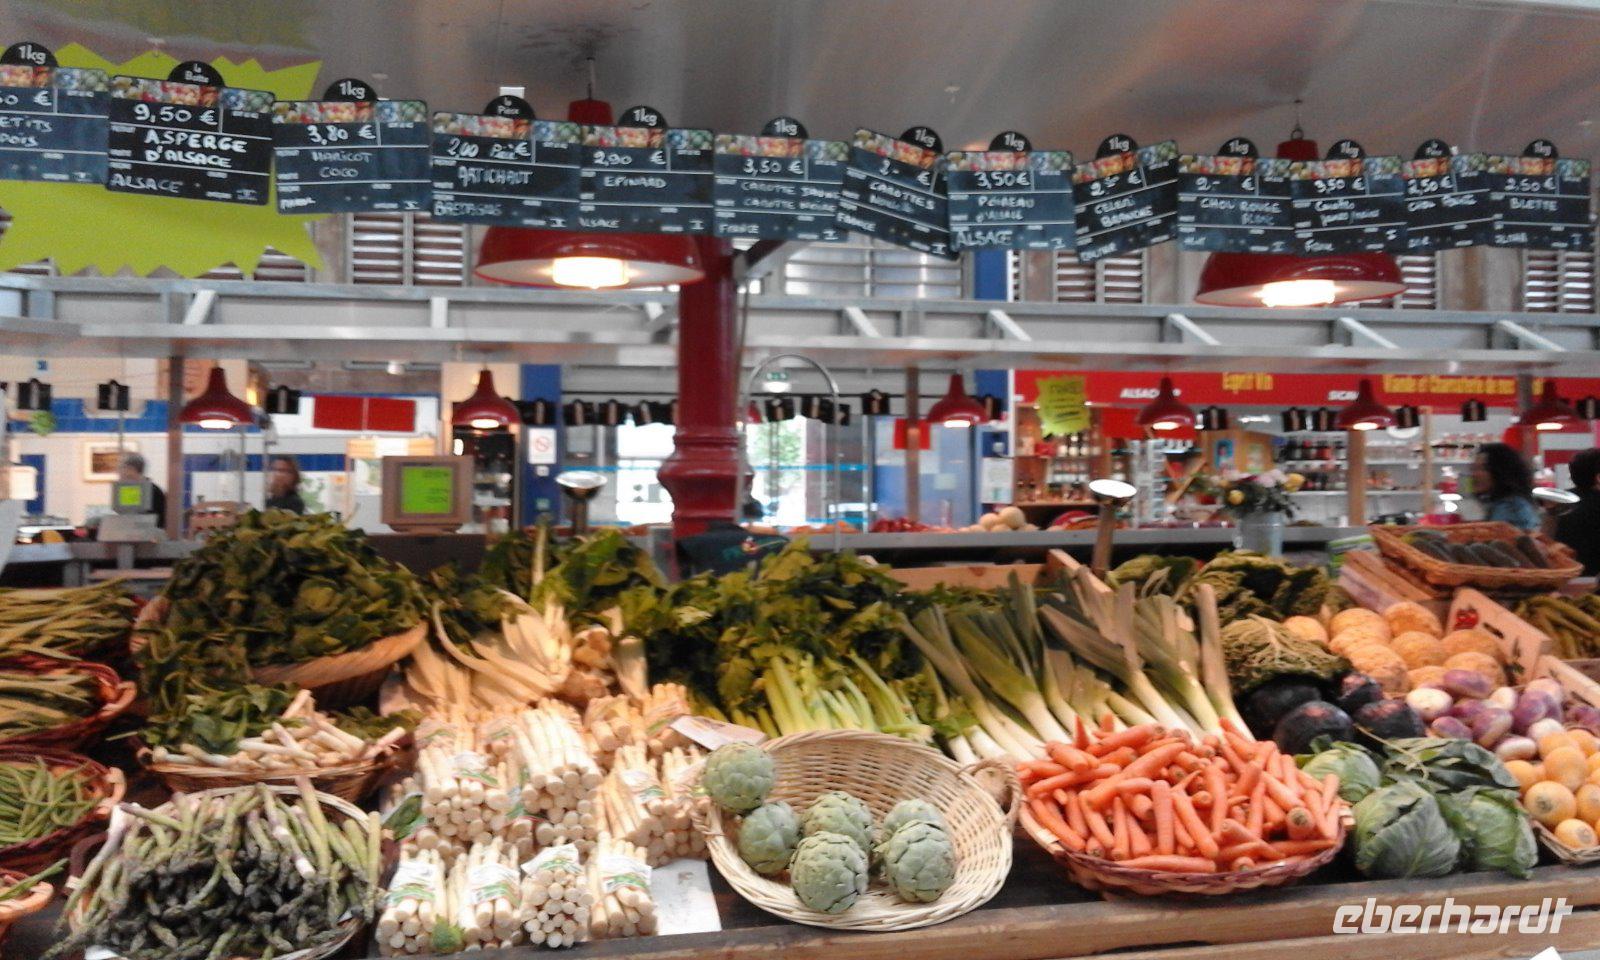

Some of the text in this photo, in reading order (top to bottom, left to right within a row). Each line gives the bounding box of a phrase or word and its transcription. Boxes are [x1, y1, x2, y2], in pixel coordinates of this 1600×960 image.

[19, 44, 47, 65] 1kg
[339, 80, 366, 100] 1kg
[133, 103, 192, 123] 9,50
[199, 110, 218, 126] €
[633, 107, 658, 127] 1kg
[358, 124, 376, 139] €
[774, 118, 798, 137] 1kg
[144, 129, 249, 153] ASPERGE
[915, 128, 937, 148] 1kg
[1004, 133, 1026, 151] 1kg
[1109, 136, 1130, 152] 1kg
[1229, 139, 1250, 155] 1kg
[144, 146, 232, 168] D'ALSACE
[650, 150, 667, 165] €
[743, 158, 805, 178] 3,50 €
[111, 173, 184, 193] ALSACE
[974, 171, 1031, 190] 3,50 €
[950, 229, 1014, 252] ALSACE
